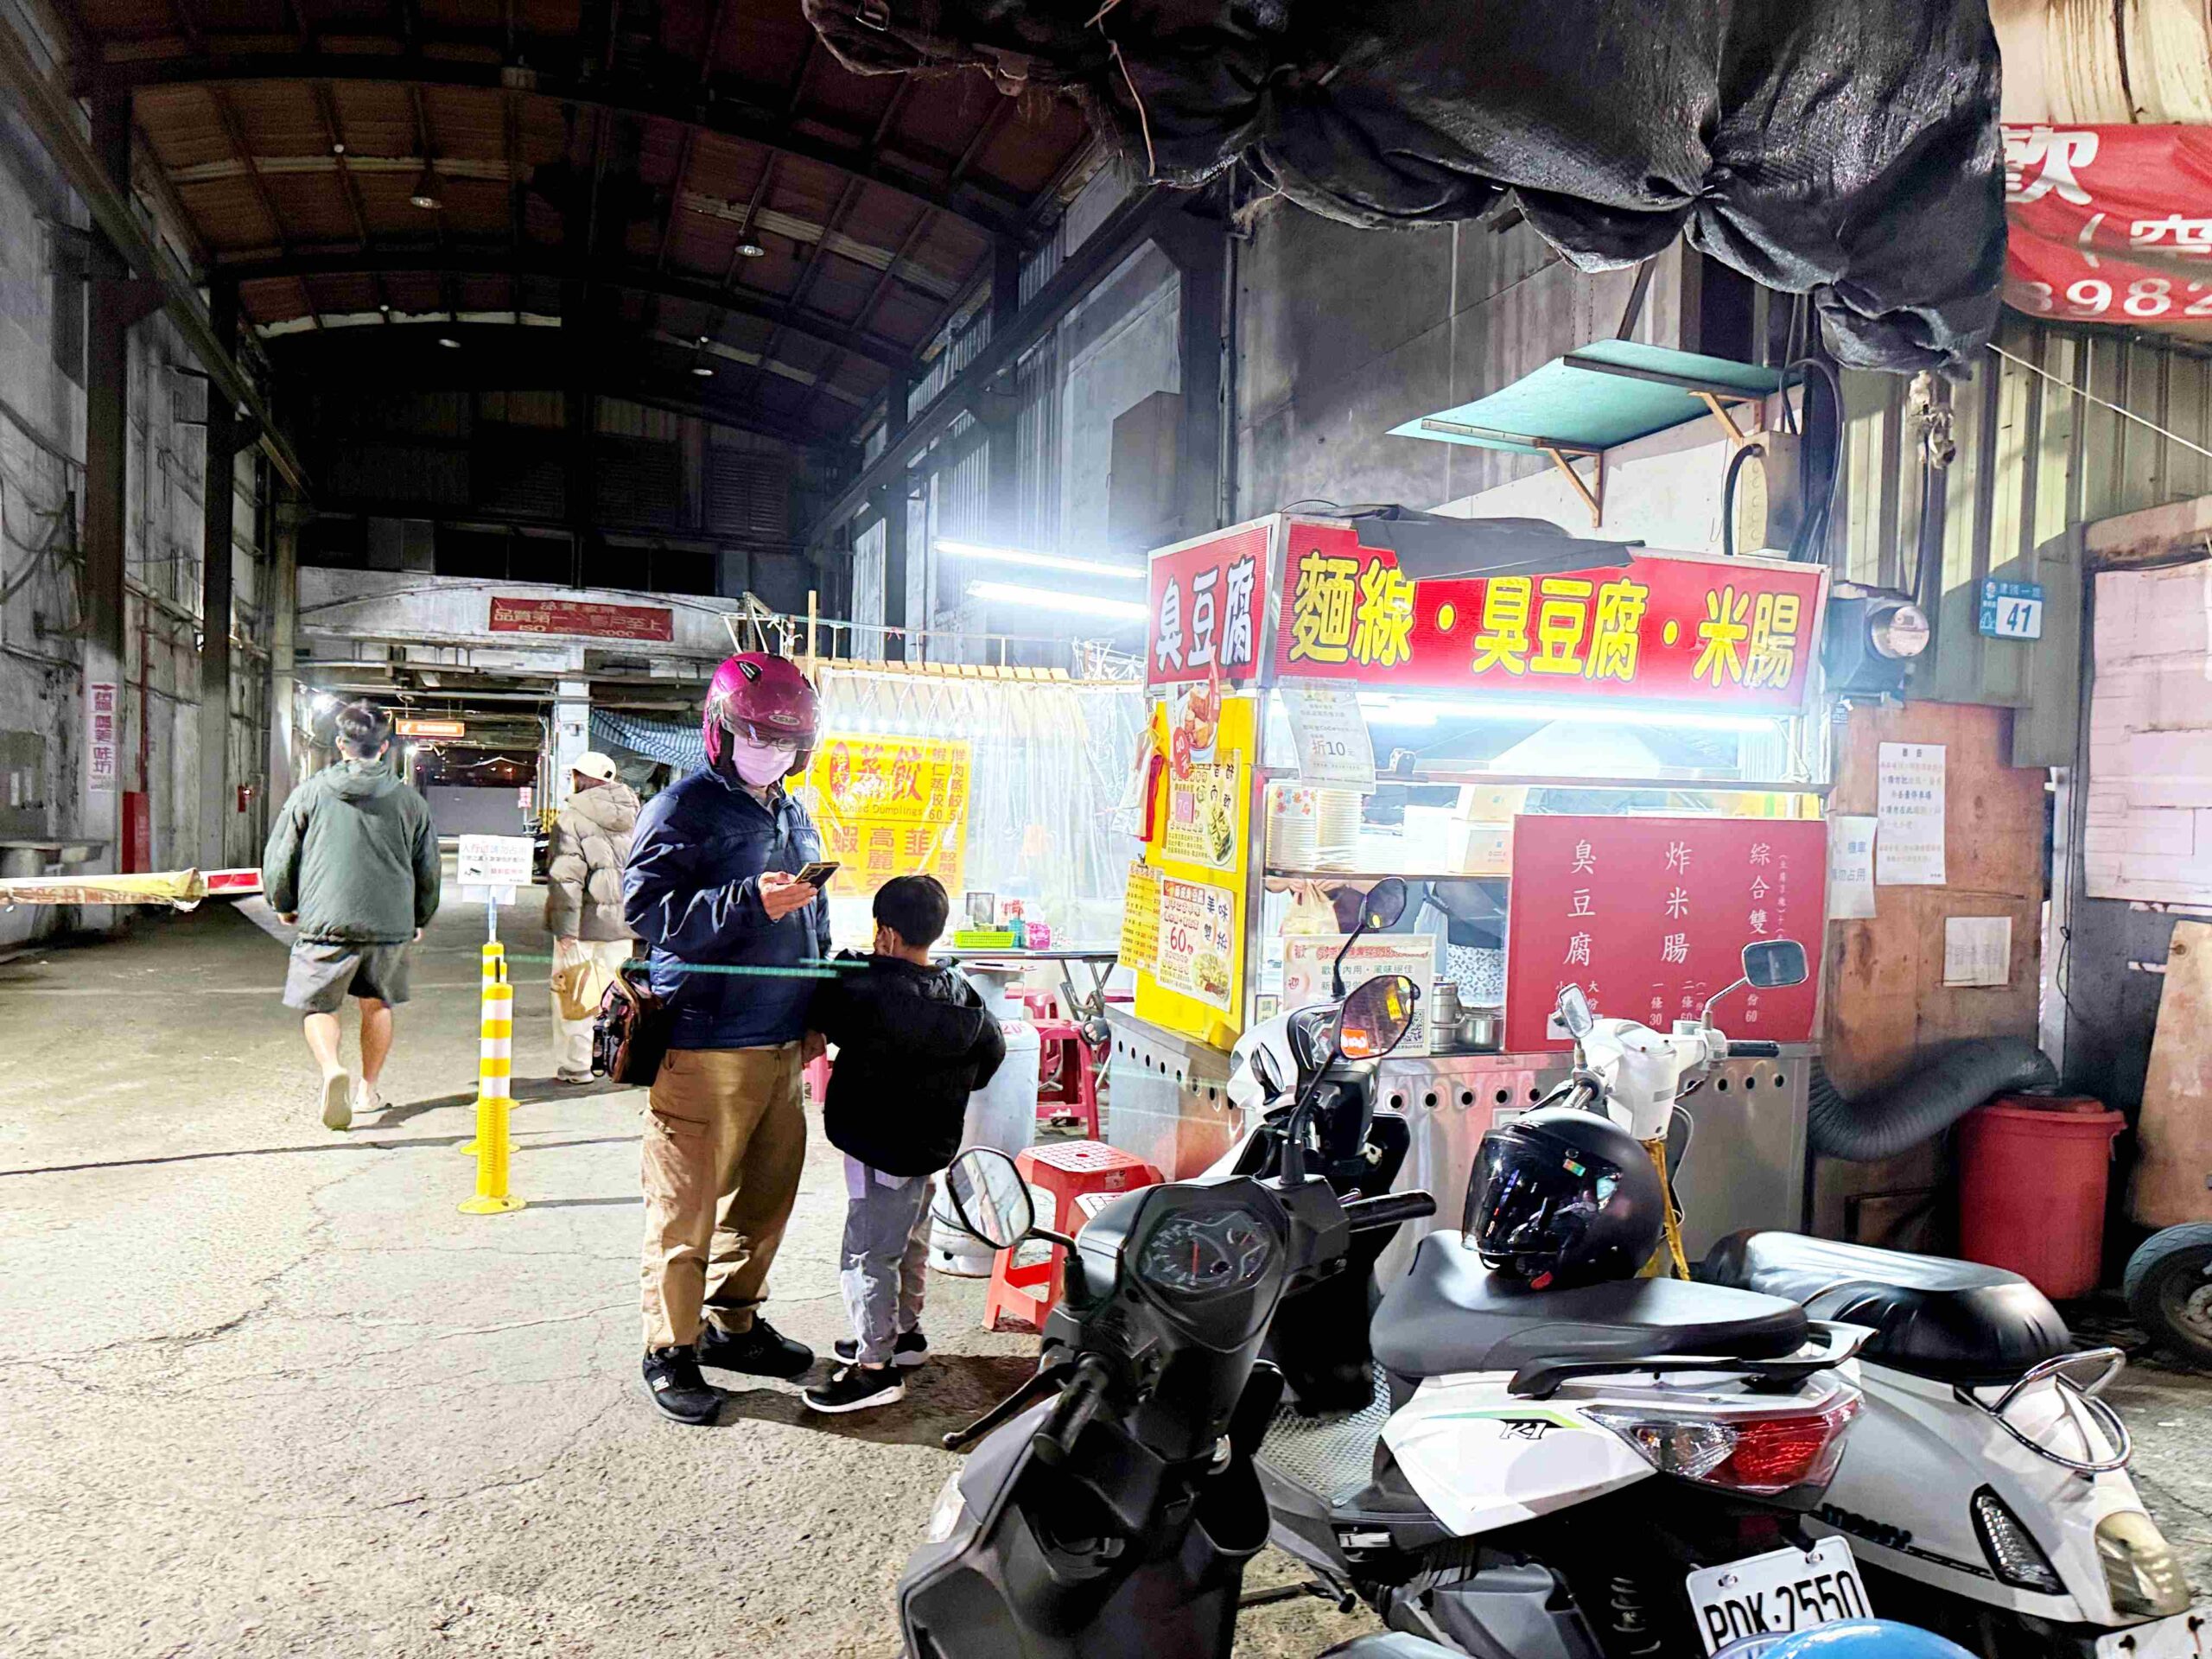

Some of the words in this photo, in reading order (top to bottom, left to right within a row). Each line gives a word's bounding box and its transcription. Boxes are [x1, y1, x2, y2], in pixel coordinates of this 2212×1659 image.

[1155, 553, 1255, 671] 臭豆腐
[2006, 602, 2032, 632] 41
[872, 804, 924, 817] Dumplings
[929, 810, 943, 820] 60
[831, 826, 858, 892] 蝦仁
[1562, 839, 1597, 967] 臭豆腐
[1660, 841, 1693, 965] 炸米腸
[1170, 926, 1186, 952] 60
[1649, 1014, 1662, 1026] 30
[1745, 1010, 1758, 1022] 60
